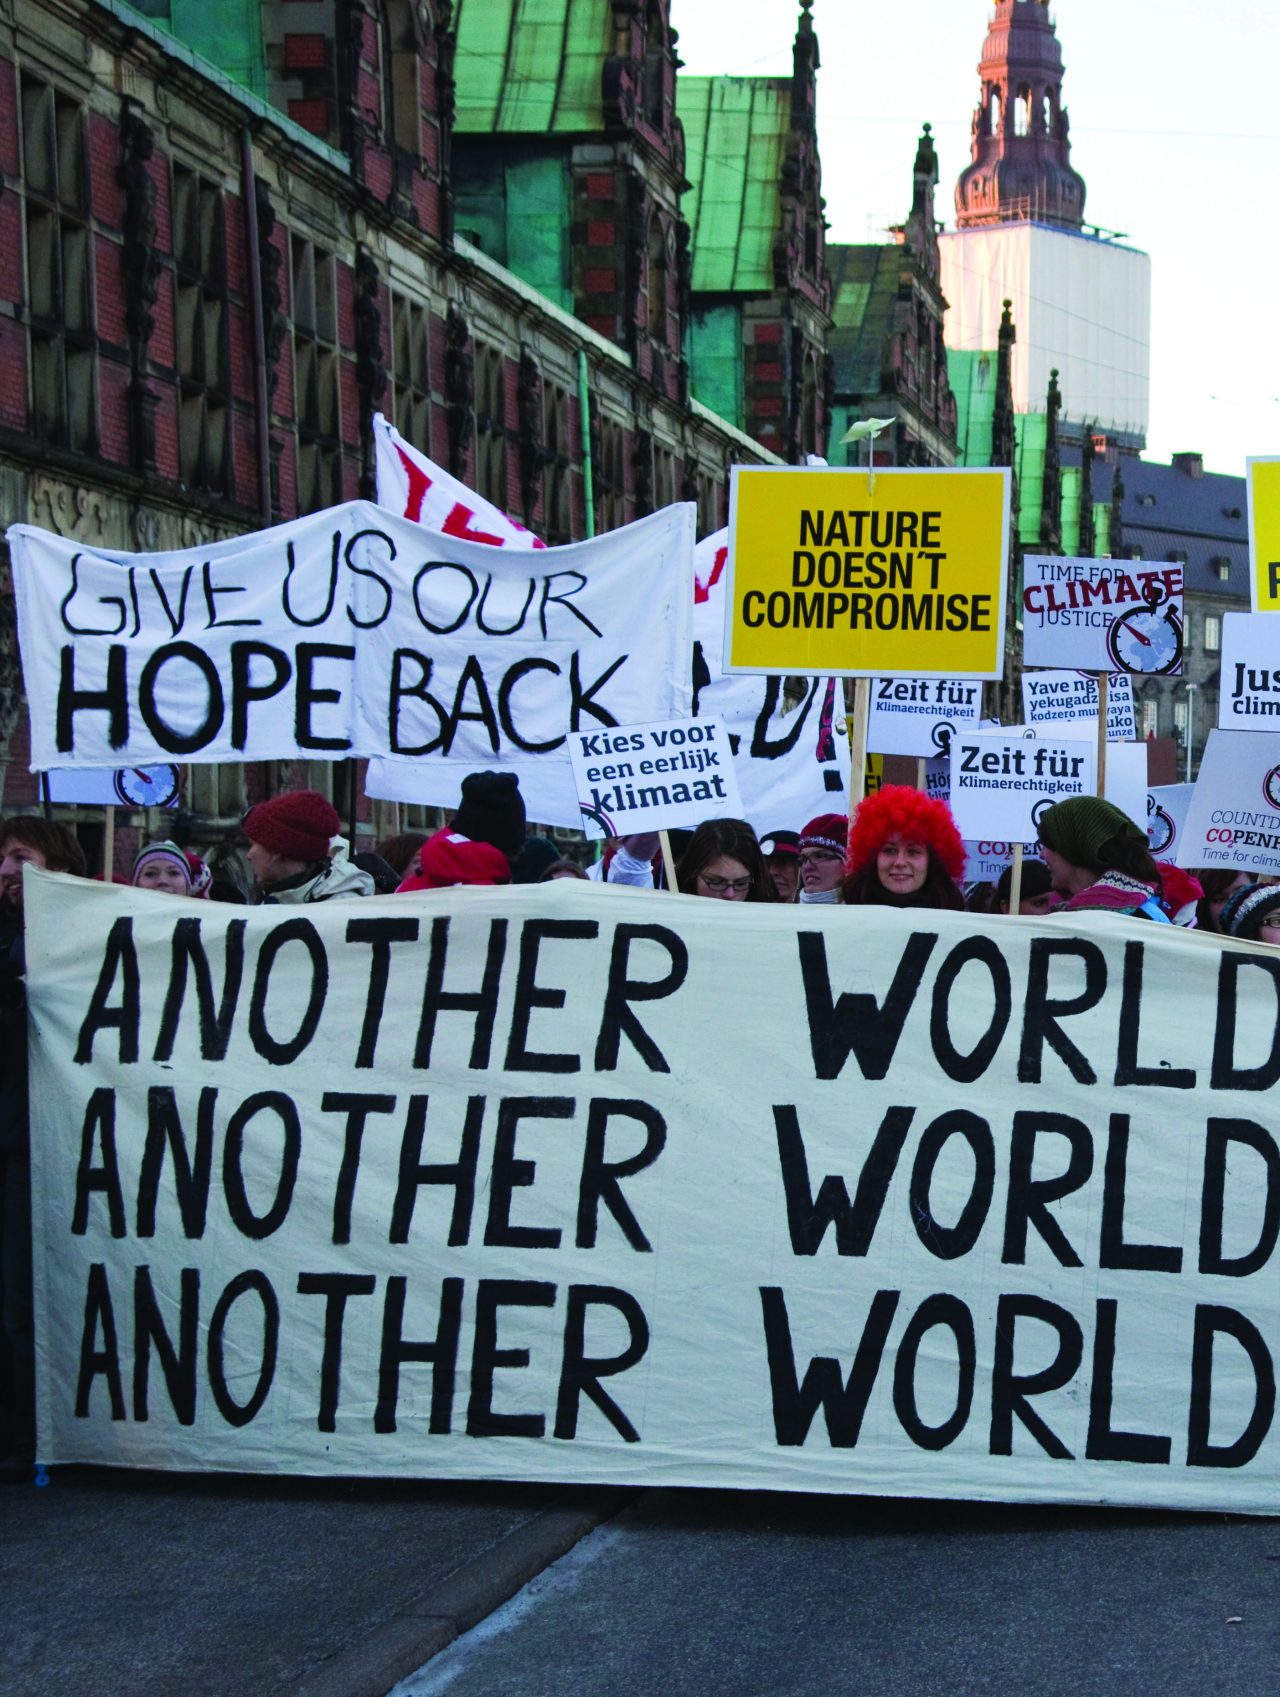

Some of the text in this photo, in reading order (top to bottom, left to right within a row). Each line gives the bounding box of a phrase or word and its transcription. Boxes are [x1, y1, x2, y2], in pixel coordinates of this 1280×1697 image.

[799, 509, 942, 550] NATURE
[60, 552, 262, 638] GIVE
[282, 528, 397, 629] US
[411, 561, 603, 640] OUR
[1023, 568, 1184, 614] CLIMATE
[1038, 564, 1125, 585] TIME FOR
[742, 591, 991, 633] COMPROMISE
[1039, 609, 1114, 628] JUSTICE
[55, 640, 356, 755] HOPE
[388, 647, 629, 756] BACK
[878, 678, 977, 705] Zeit für
[1028, 676, 1129, 695] Yave ngva
[1030, 709, 1075, 722] kodzero
[580, 724, 716, 758] Kies voor
[586, 748, 720, 782] een eerlijk
[960, 745, 1084, 778] Zeit für
[590, 774, 728, 813] klimaat
[978, 861, 1009, 873] Time
[1202, 847, 1230, 861] Time
[1233, 849, 1249, 863] for
[73, 916, 689, 1075] ANOTHER
[71, 1086, 668, 1253] ANOTHER
[74, 1264, 651, 1443] ANOTHER
[758, 1286, 1277, 1468] WORLD
